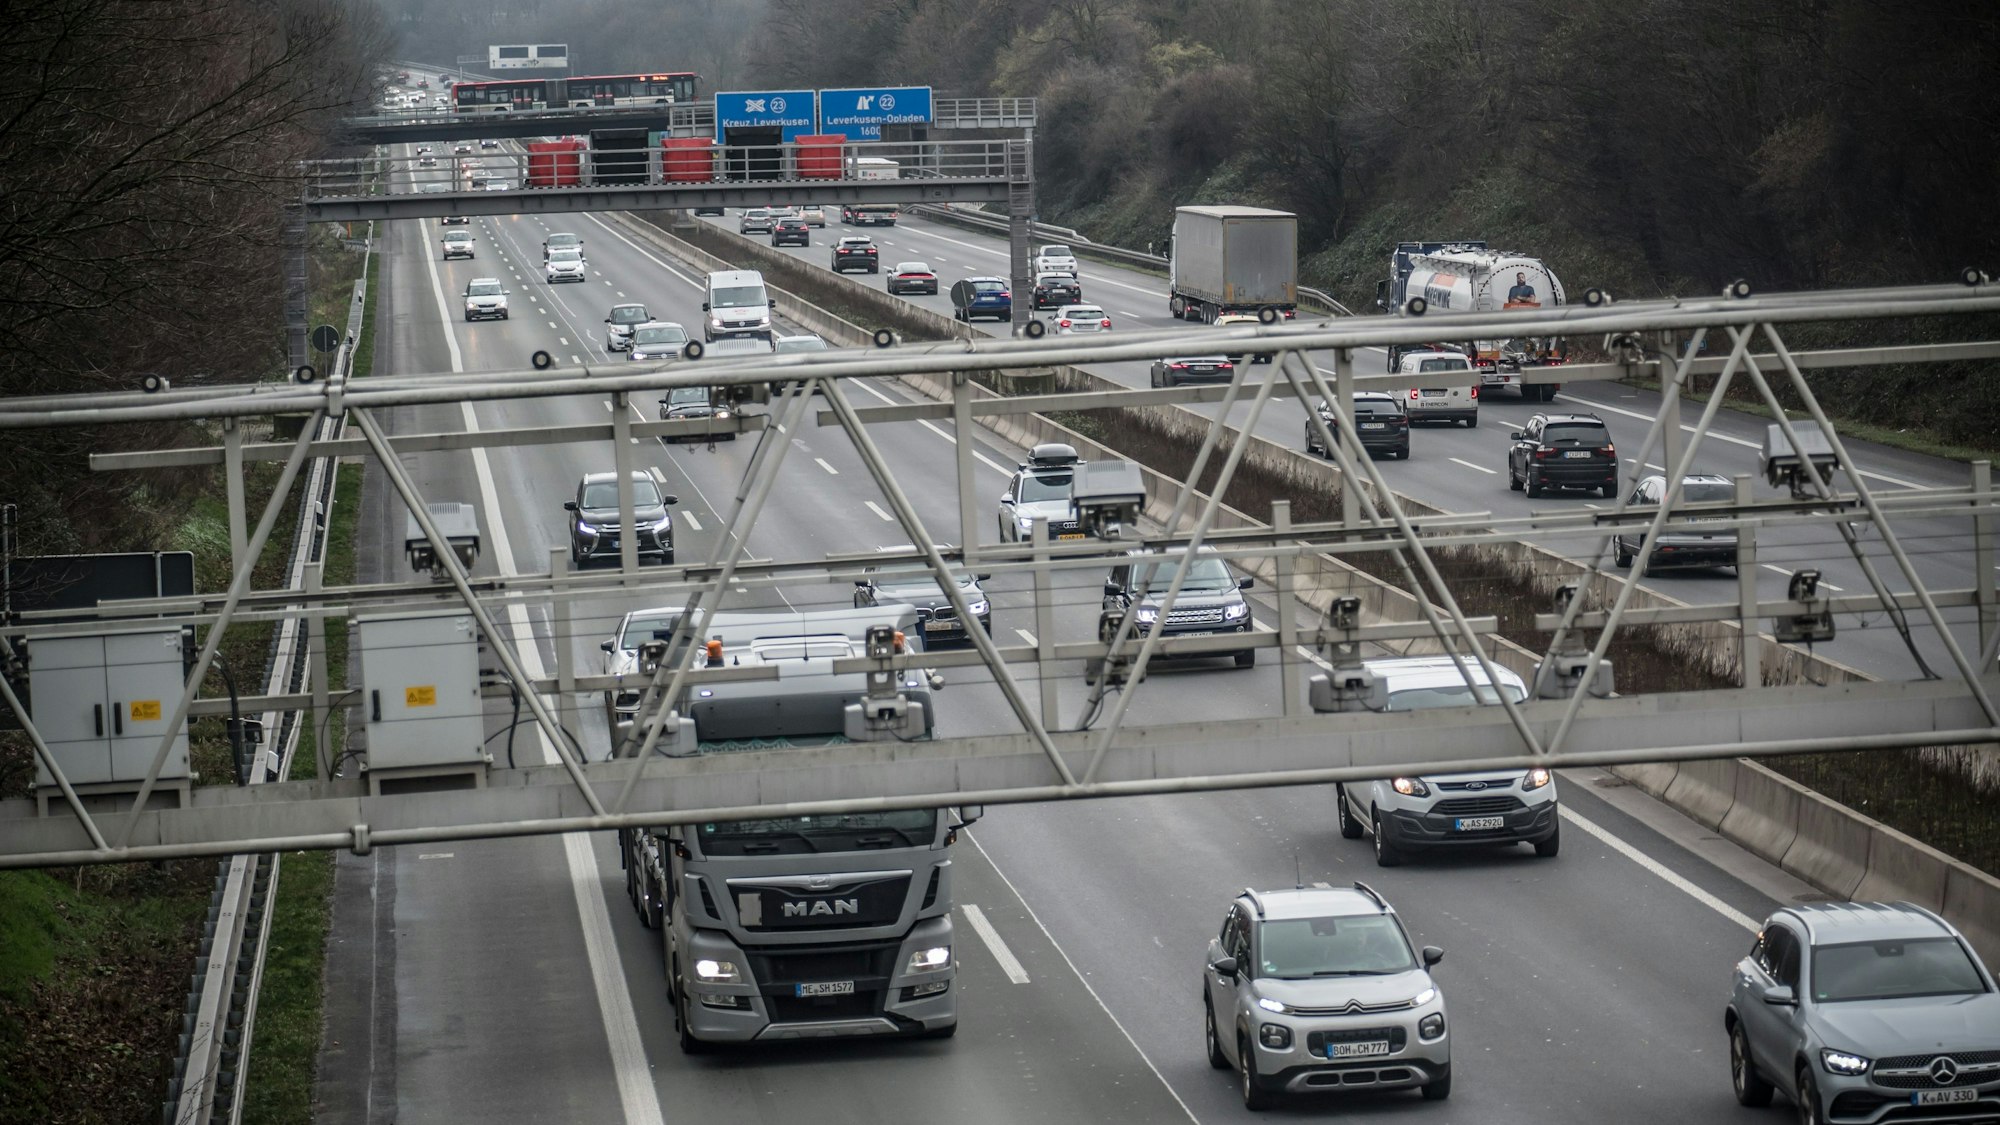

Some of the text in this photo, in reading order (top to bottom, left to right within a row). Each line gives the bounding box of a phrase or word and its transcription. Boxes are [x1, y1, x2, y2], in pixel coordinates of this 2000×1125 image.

[773, 100, 784, 110] 23
[881, 97, 892, 107] 22
[722, 117, 809, 128] Kreuz Leverkusen
[826, 113, 925, 125] Leverkusen-Opladen
[784, 899, 858, 917] MAN
